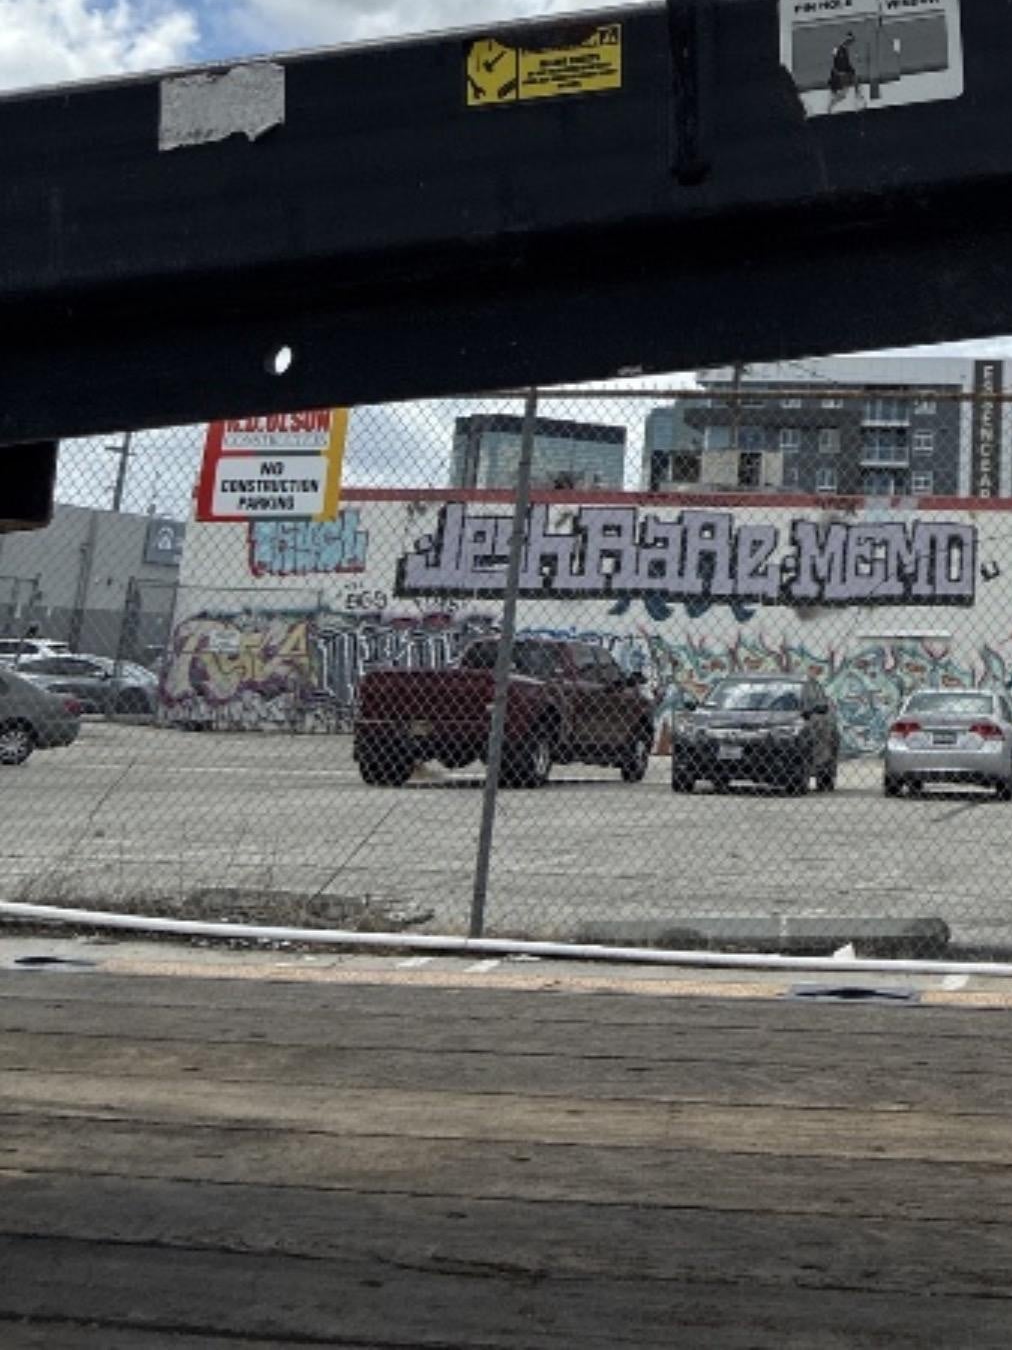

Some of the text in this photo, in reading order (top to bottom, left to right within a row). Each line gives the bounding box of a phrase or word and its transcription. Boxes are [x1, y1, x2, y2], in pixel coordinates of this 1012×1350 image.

[260, 461, 285, 476] NO
[220, 479, 319, 494] CONSTRUCTION
[238, 495, 295, 511] PARKING
